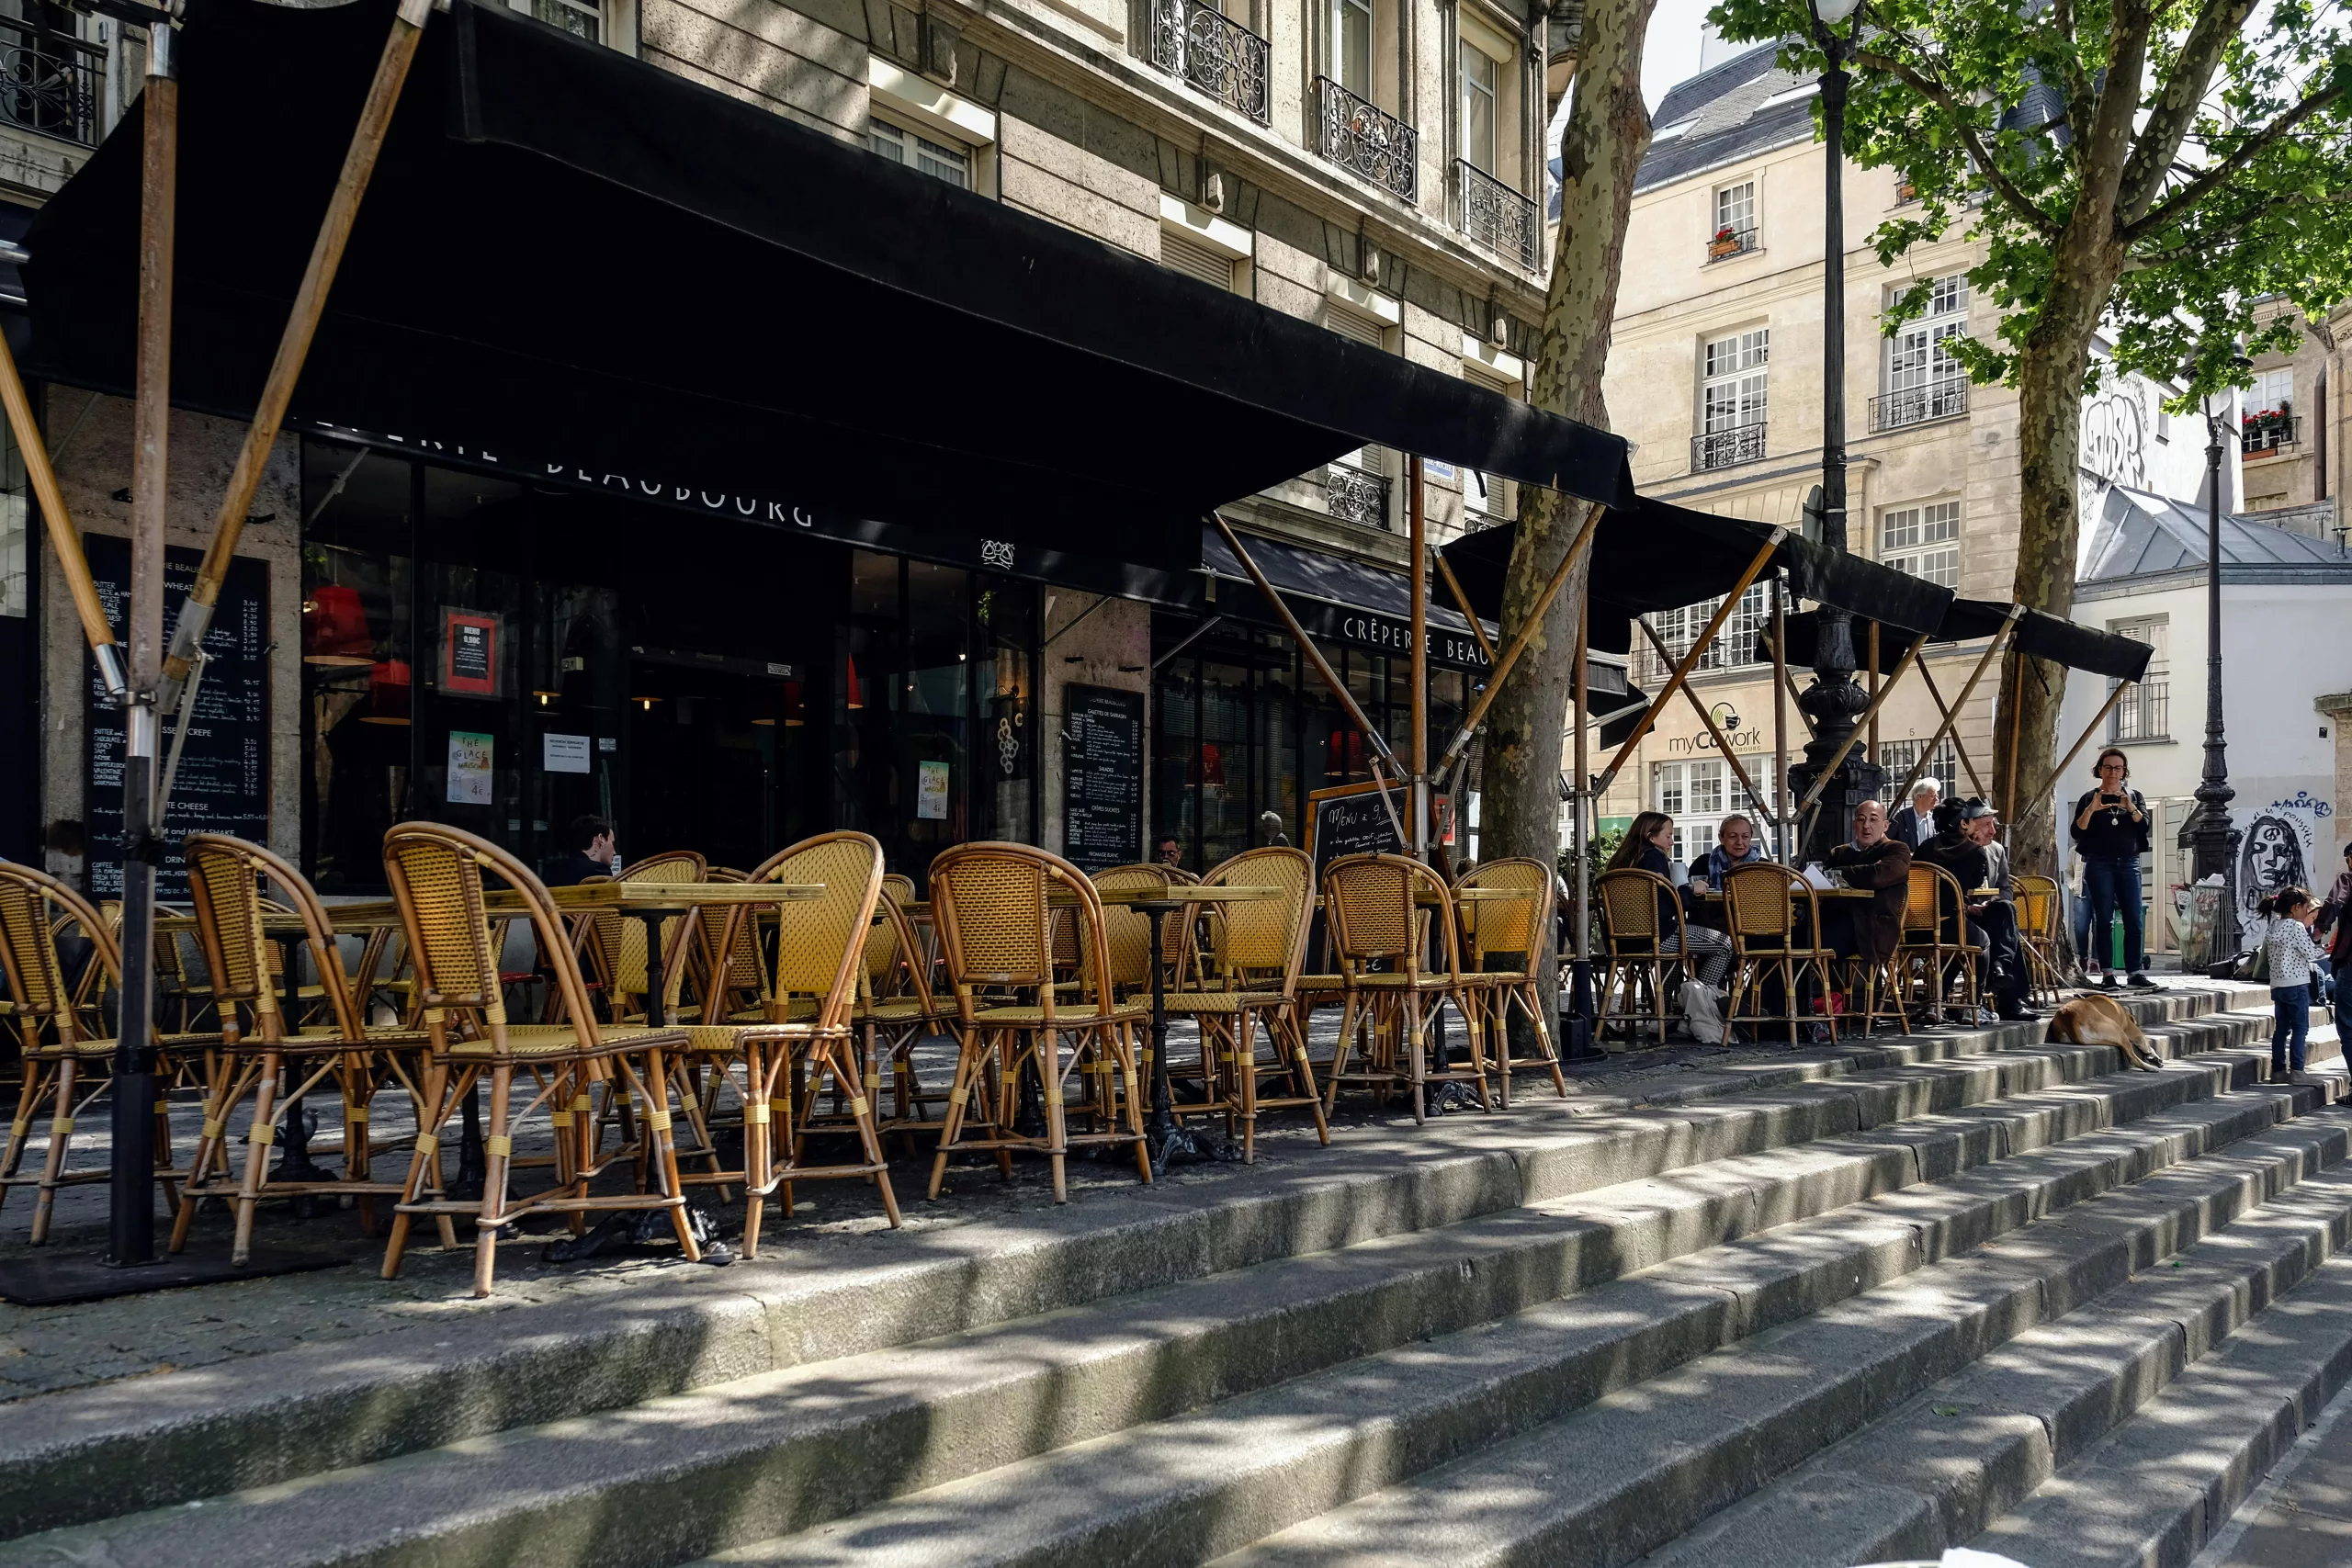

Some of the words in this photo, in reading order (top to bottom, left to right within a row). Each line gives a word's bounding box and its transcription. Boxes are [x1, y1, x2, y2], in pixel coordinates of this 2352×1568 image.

[164, 581, 193, 592] WHEAT
[1344, 618, 1431, 653] CRÊPERE
[187, 728, 212, 737] CREPE
[1909, 728, 1915, 737] 5
[177, 802, 209, 810] CHEESE
[1329, 807, 1357, 832] MENU
